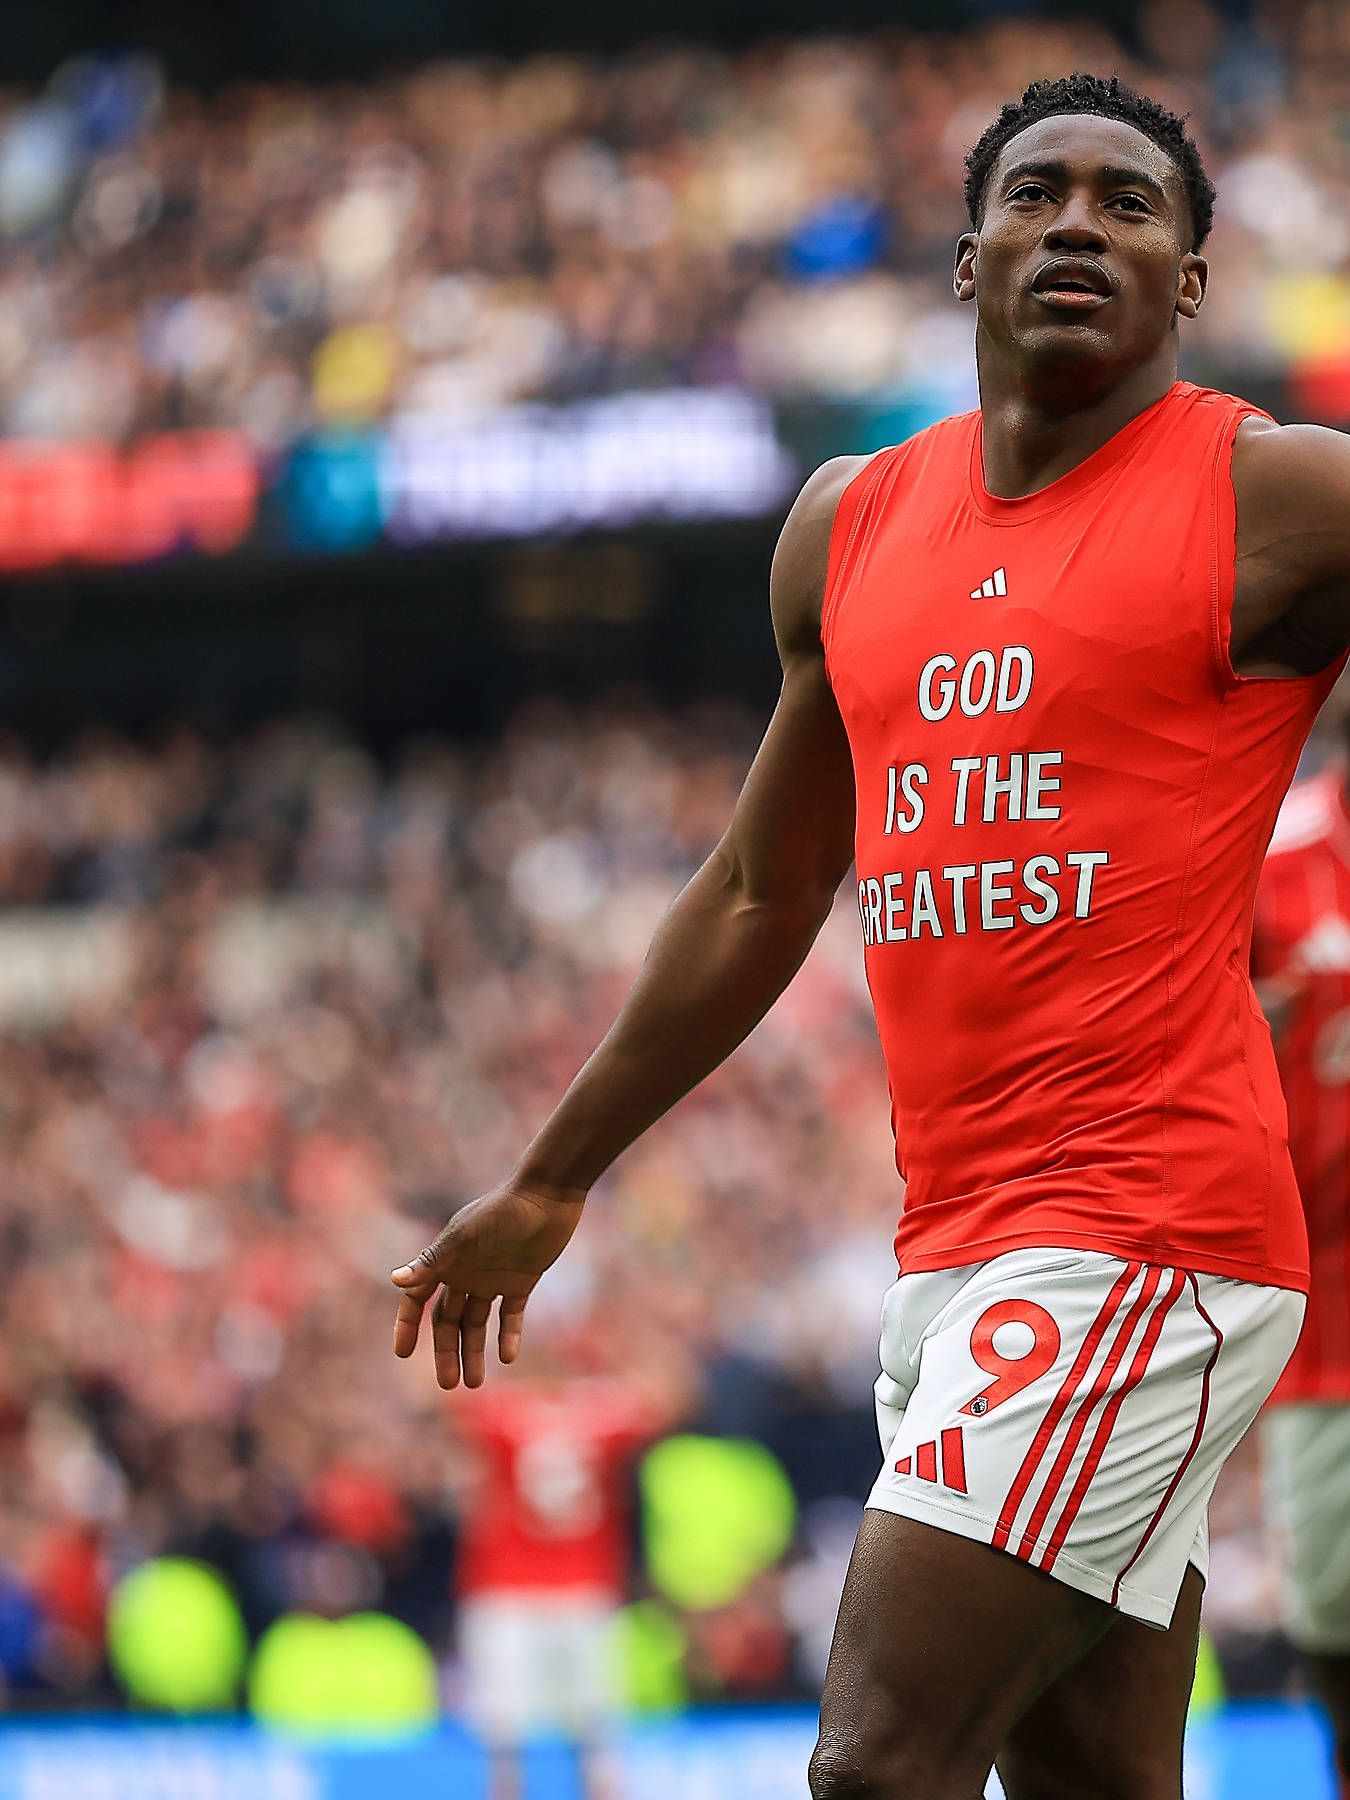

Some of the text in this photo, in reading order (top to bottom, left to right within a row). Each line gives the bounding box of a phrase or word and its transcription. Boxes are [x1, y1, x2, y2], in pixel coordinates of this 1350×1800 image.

[917, 644, 1035, 722] GOD
[882, 750, 1064, 836] IS THE
[857, 850, 1110, 947] GREATEST
[957, 1298, 1062, 1418] 9
